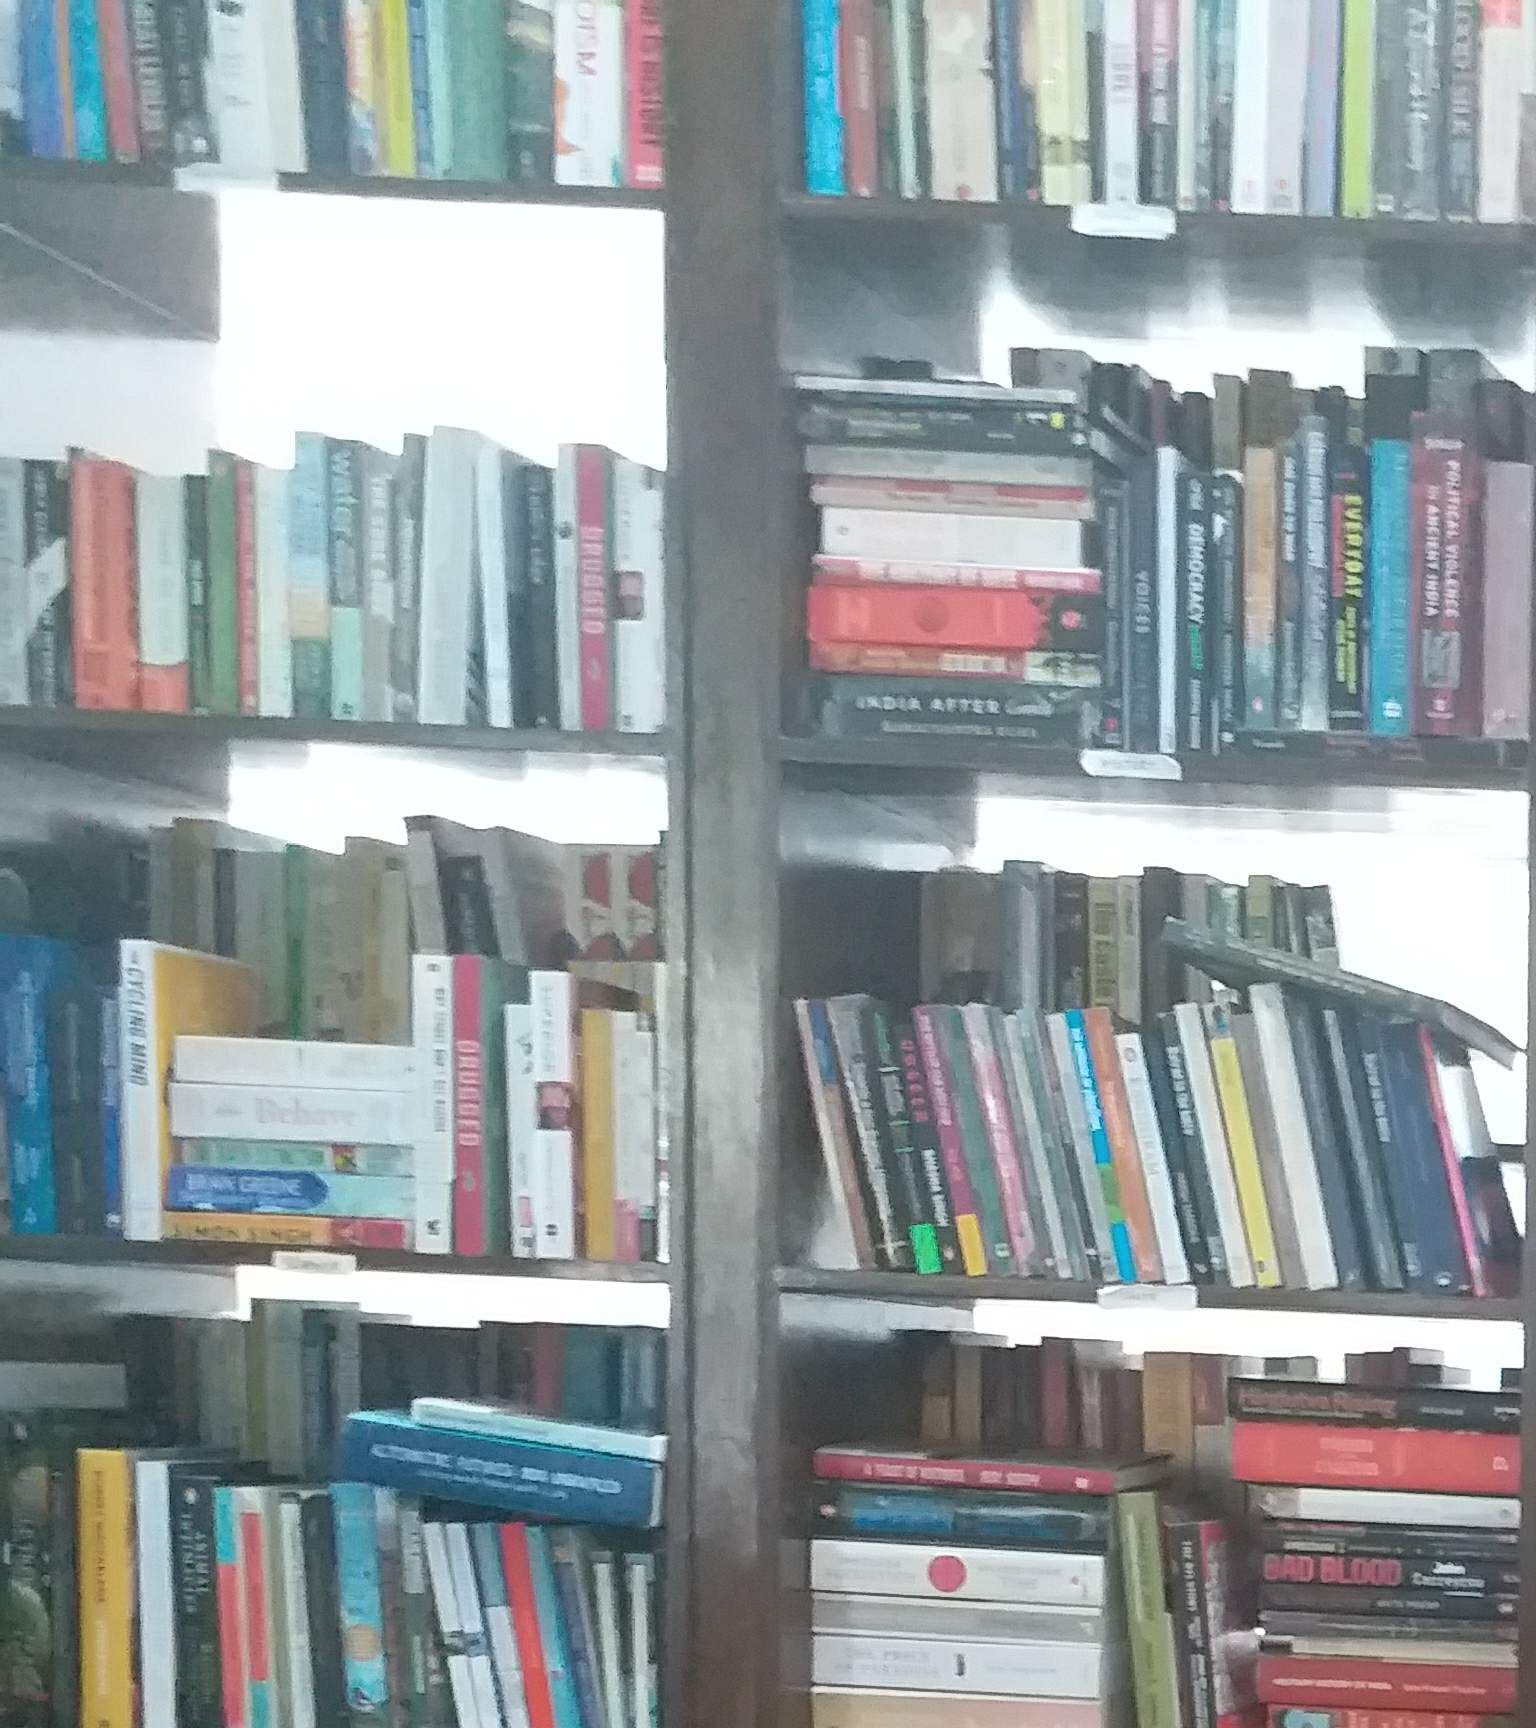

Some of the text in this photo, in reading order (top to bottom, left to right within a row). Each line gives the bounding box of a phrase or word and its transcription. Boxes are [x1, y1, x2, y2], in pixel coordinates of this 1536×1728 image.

[1187, 522, 1207, 625] DEMOCRACY
[1342, 493, 1364, 599] EVERYDAY
[1424, 504, 1441, 571] ANCIENT
[1444, 461, 1463, 619] POLITICAL VIOLENCE
[1424, 575, 1440, 617] INDIA
[1264, 1553, 1403, 1586] BAD BLOOD
